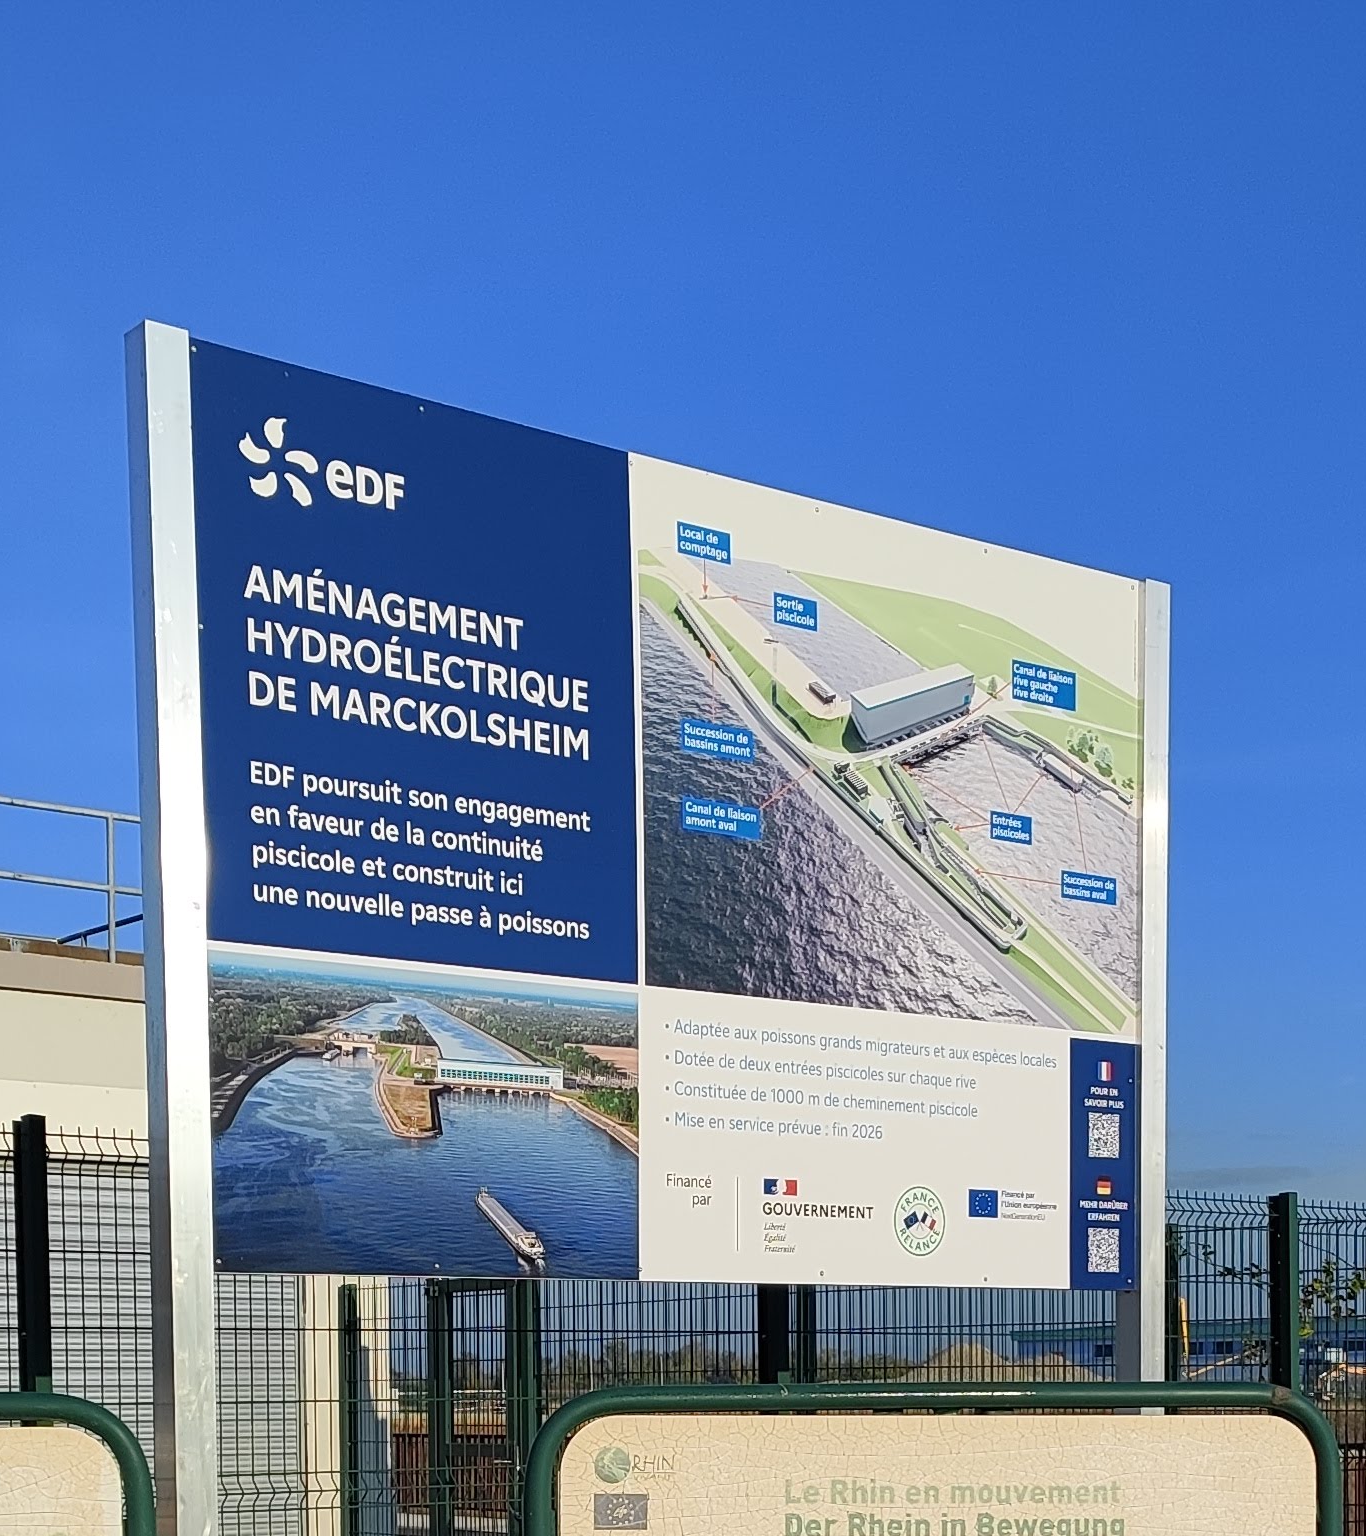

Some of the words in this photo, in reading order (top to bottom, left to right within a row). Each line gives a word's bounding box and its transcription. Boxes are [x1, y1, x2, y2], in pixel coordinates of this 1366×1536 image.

[679, 526, 704, 541] Local
[706, 533, 718, 544] de
[680, 540, 727, 560] comptage
[243, 564, 523, 651] AMÉNAGEMENT
[777, 597, 804, 611] Sortie
[777, 610, 814, 627] piscicole
[246, 618, 589, 713] HYDROÉLECTRIQUE
[1014, 664, 1035, 677] Canal
[1037, 668, 1047, 680] de
[1048, 670, 1073, 685] liaison
[1014, 675, 1028, 687] rive
[1030, 679, 1058, 694] gauche
[1014, 687, 1028, 698] rive
[1029, 690, 1053, 703] droite
[249, 671, 297, 712] DE
[310, 681, 589, 761] MARCKOLSHEIM
[684, 723, 734, 742] Succession
[737, 733, 748, 744] de
[684, 735, 718, 751] bassins
[721, 745, 750, 757] amont
[250, 760, 295, 789] EDF
[303, 769, 403, 807] poursuit
[408, 783, 448, 812] son
[455, 792, 591, 832] engagement
[686, 802, 711, 815] Canal
[714, 806, 725, 817] de
[728, 808, 756, 822] liaison
[993, 815, 1022, 828] Entrées
[251, 805, 281, 827] en
[287, 805, 363, 837] faveur
[370, 814, 399, 843] de
[405, 820, 425, 846] la
[431, 826, 543, 862] continuité
[686, 816, 716, 828] amont
[718, 821, 737, 831] aval
[252, 840, 355, 876] piscicole
[361, 854, 386, 879] et
[393, 858, 494, 894] construit
[500, 871, 523, 896] ici
[1105, 880, 1114, 891] de
[253, 881, 298, 906] une
[306, 888, 404, 919] nouvelle
[411, 902, 473, 928] passe
[479, 905, 491, 929] à
[499, 911, 589, 940] poissons
[674, 1019, 730, 1039] Adaptée
[734, 1028, 757, 1041] aux
[761, 1028, 816, 1046] poissons
[820, 1035, 861, 1051] grands
[866, 1038, 930, 1056] migrateurs
[934, 1045, 945, 1058] et
[949, 1047, 969, 1060] aux
[973, 1050, 1017, 1065] espèces
[1020, 1052, 1056, 1068] locales
[675, 1050, 714, 1067] Dotée
[719, 1054, 735, 1068] de
[739, 1055, 771, 1072] deux
[775, 1060, 822, 1076] entrées
[826, 1063, 884, 1081] piscicoles
[888, 1070, 906, 1083] sur
[910, 1070, 952, 1089] chaque
[956, 1073, 976, 1089] rive
[674, 1080, 746, 1100] Constituée
[751, 1087, 766, 1101] de
[771, 1088, 804, 1105] 1000
[809, 1094, 820, 1106] m
[824, 1093, 839, 1107] de
[843, 1093, 925, 1115] cheminement
[929, 1102, 978, 1118] piscicole
[1090, 1087, 1108, 1096] POUR
[1110, 1088, 1118, 1097] EN
[1084, 1099, 1108, 1107] SAVOIR
[1108, 1100, 1124, 1109] PLUS
[675, 1112, 705, 1128] Mise
[709, 1117, 724, 1129] en
[729, 1116, 774, 1132] service
[779, 1120, 821, 1136] prévue
[832, 1122, 847, 1137] fin
[852, 1123, 883, 1139] 2026
[666, 1173, 712, 1189] Financé
[692, 1194, 712, 1208] par
[900, 1191, 940, 1215] FRANCE
[1026, 1192, 1035, 1200] par
[1080, 1200, 1097, 1209] MEHR
[762, 1202, 874, 1219] GOUVERNEMENT
[763, 1222, 786, 1232] Liberté
[899, 1227, 941, 1251] RELANCE
[631, 1454, 676, 1471] RHIN
[785, 1479, 821, 1504] Le
[831, 1478, 895, 1504] Rhin
[905, 1484, 939, 1504] en
[950, 1482, 1121, 1504] mouvement
